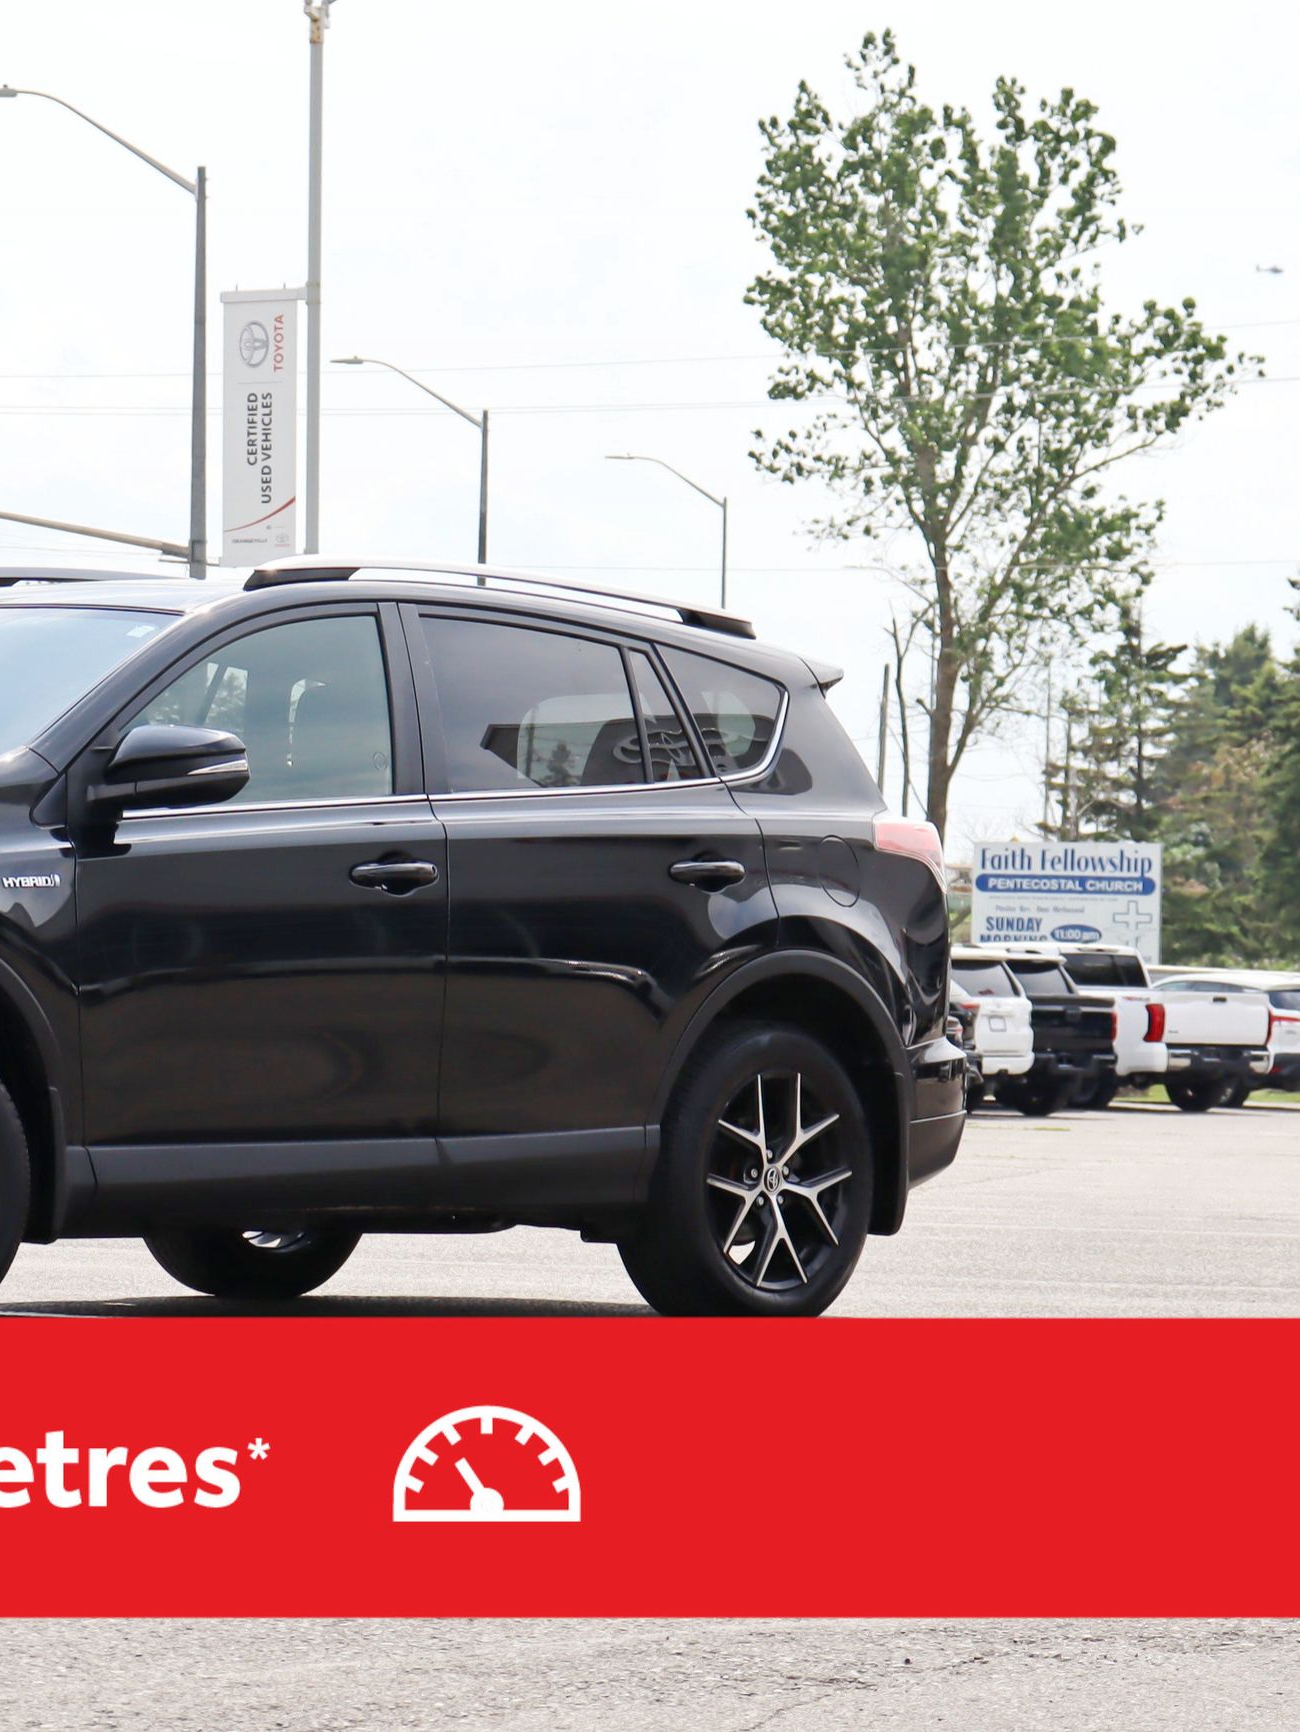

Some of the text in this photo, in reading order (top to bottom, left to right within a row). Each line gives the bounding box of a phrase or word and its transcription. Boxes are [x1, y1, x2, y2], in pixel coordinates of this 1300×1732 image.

[273, 314, 285, 373] TOYOTA
[246, 392, 258, 466] CERTIFIED
[261, 392, 273, 504] USED VEHICLES
[981, 848, 1153, 878] Faith Fellowship
[2, 875, 53, 888] HYBRID
[987, 878, 1144, 893] PENTECOSTAL CHURCH
[986, 916, 1043, 932] SUNDAY
